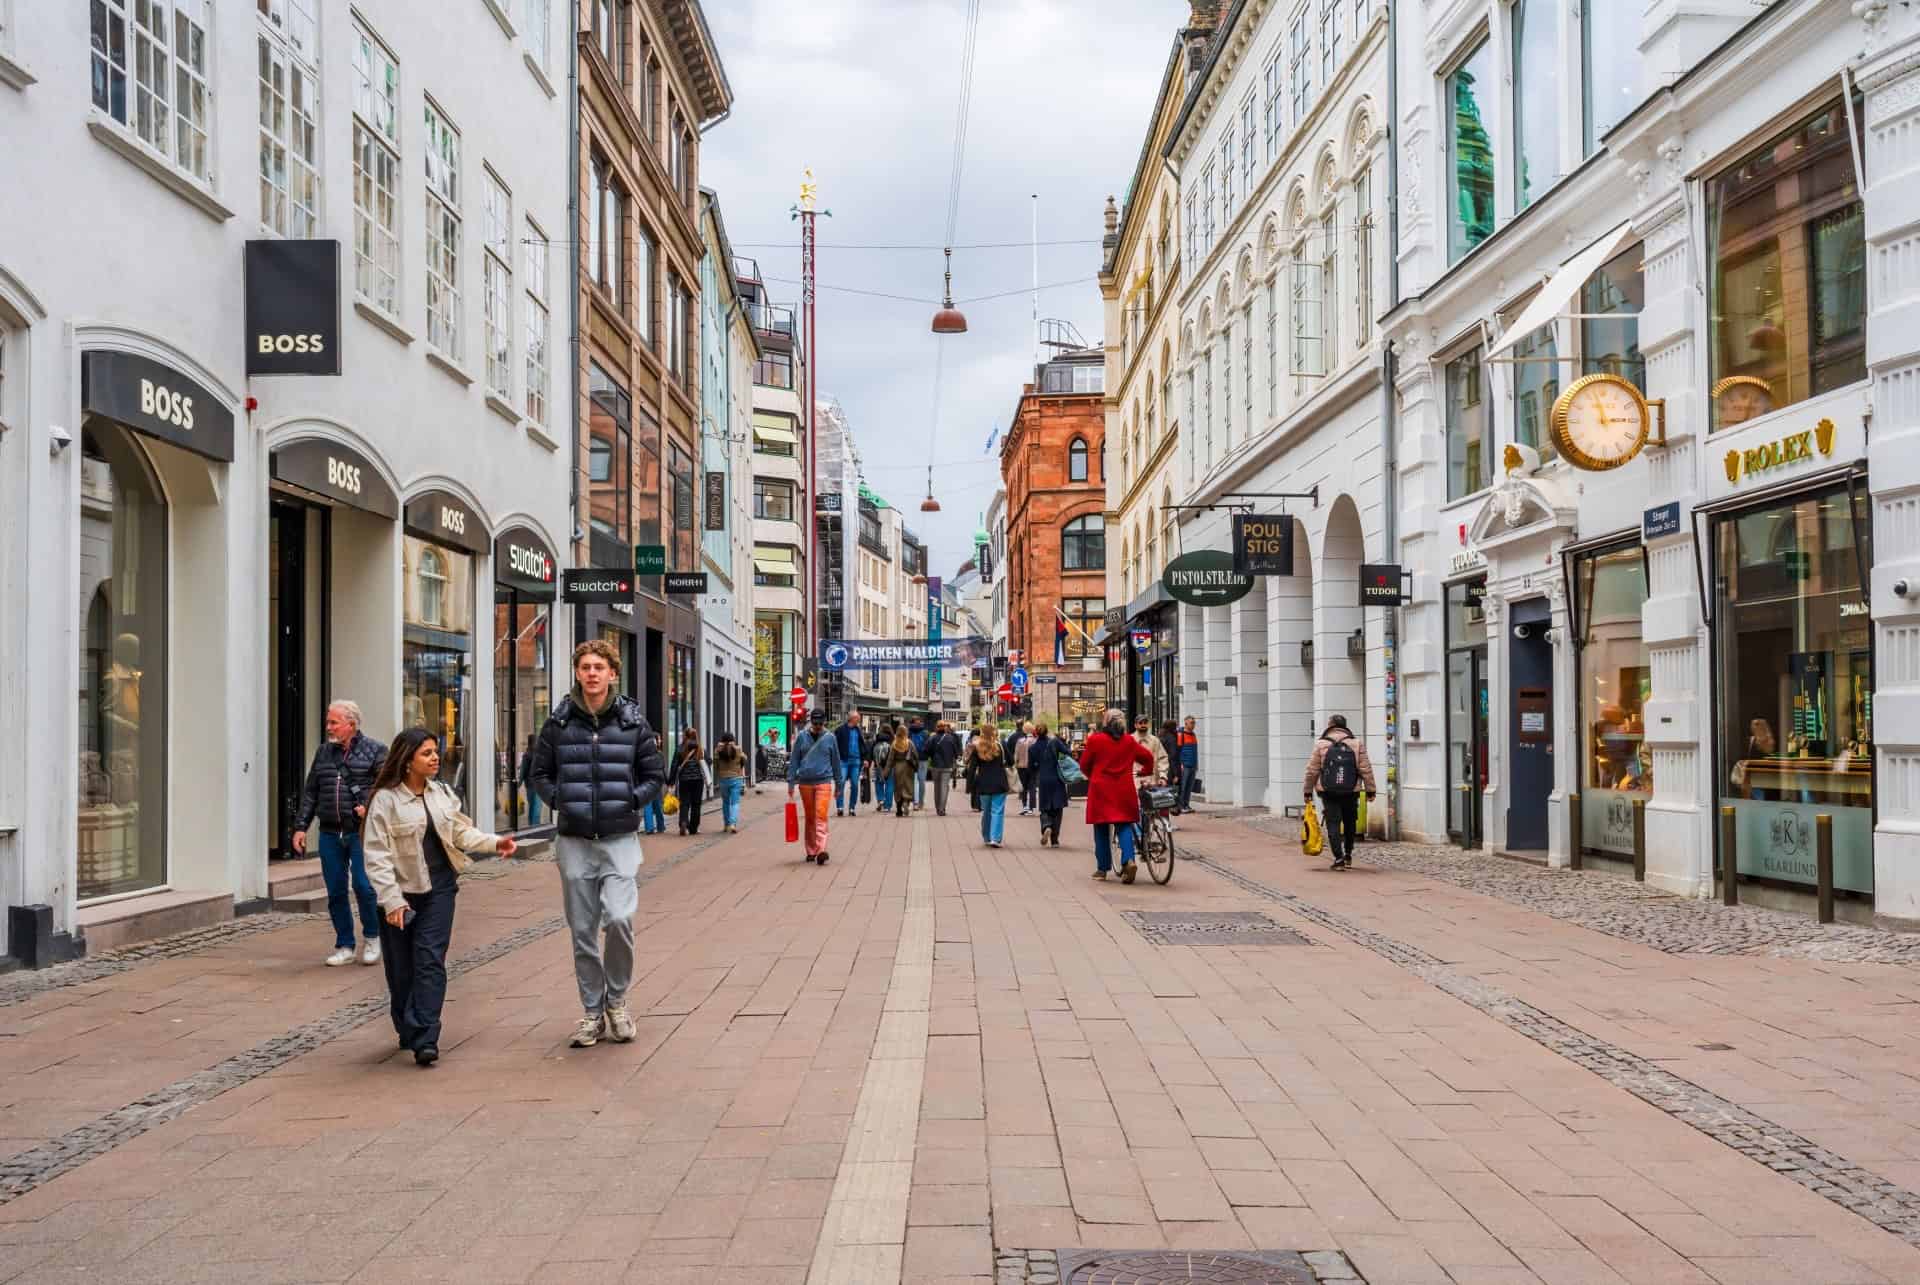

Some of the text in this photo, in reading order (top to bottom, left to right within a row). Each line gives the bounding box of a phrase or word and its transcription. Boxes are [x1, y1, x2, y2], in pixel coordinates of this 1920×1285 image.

[258, 334, 324, 353] BOSS
[141, 378, 194, 430] BOSS
[1743, 431, 1812, 476] ROLEX
[328, 456, 361, 495] BOSS
[441, 506, 465, 535] BOSS
[1243, 523, 1283, 537] POUL
[1247, 540, 1280, 554] STIG
[510, 543, 546, 581] swatch
[569, 580, 619, 592] swatch
[853, 646, 953, 660] PARKEN KALDER
[1784, 820, 1794, 844] K
